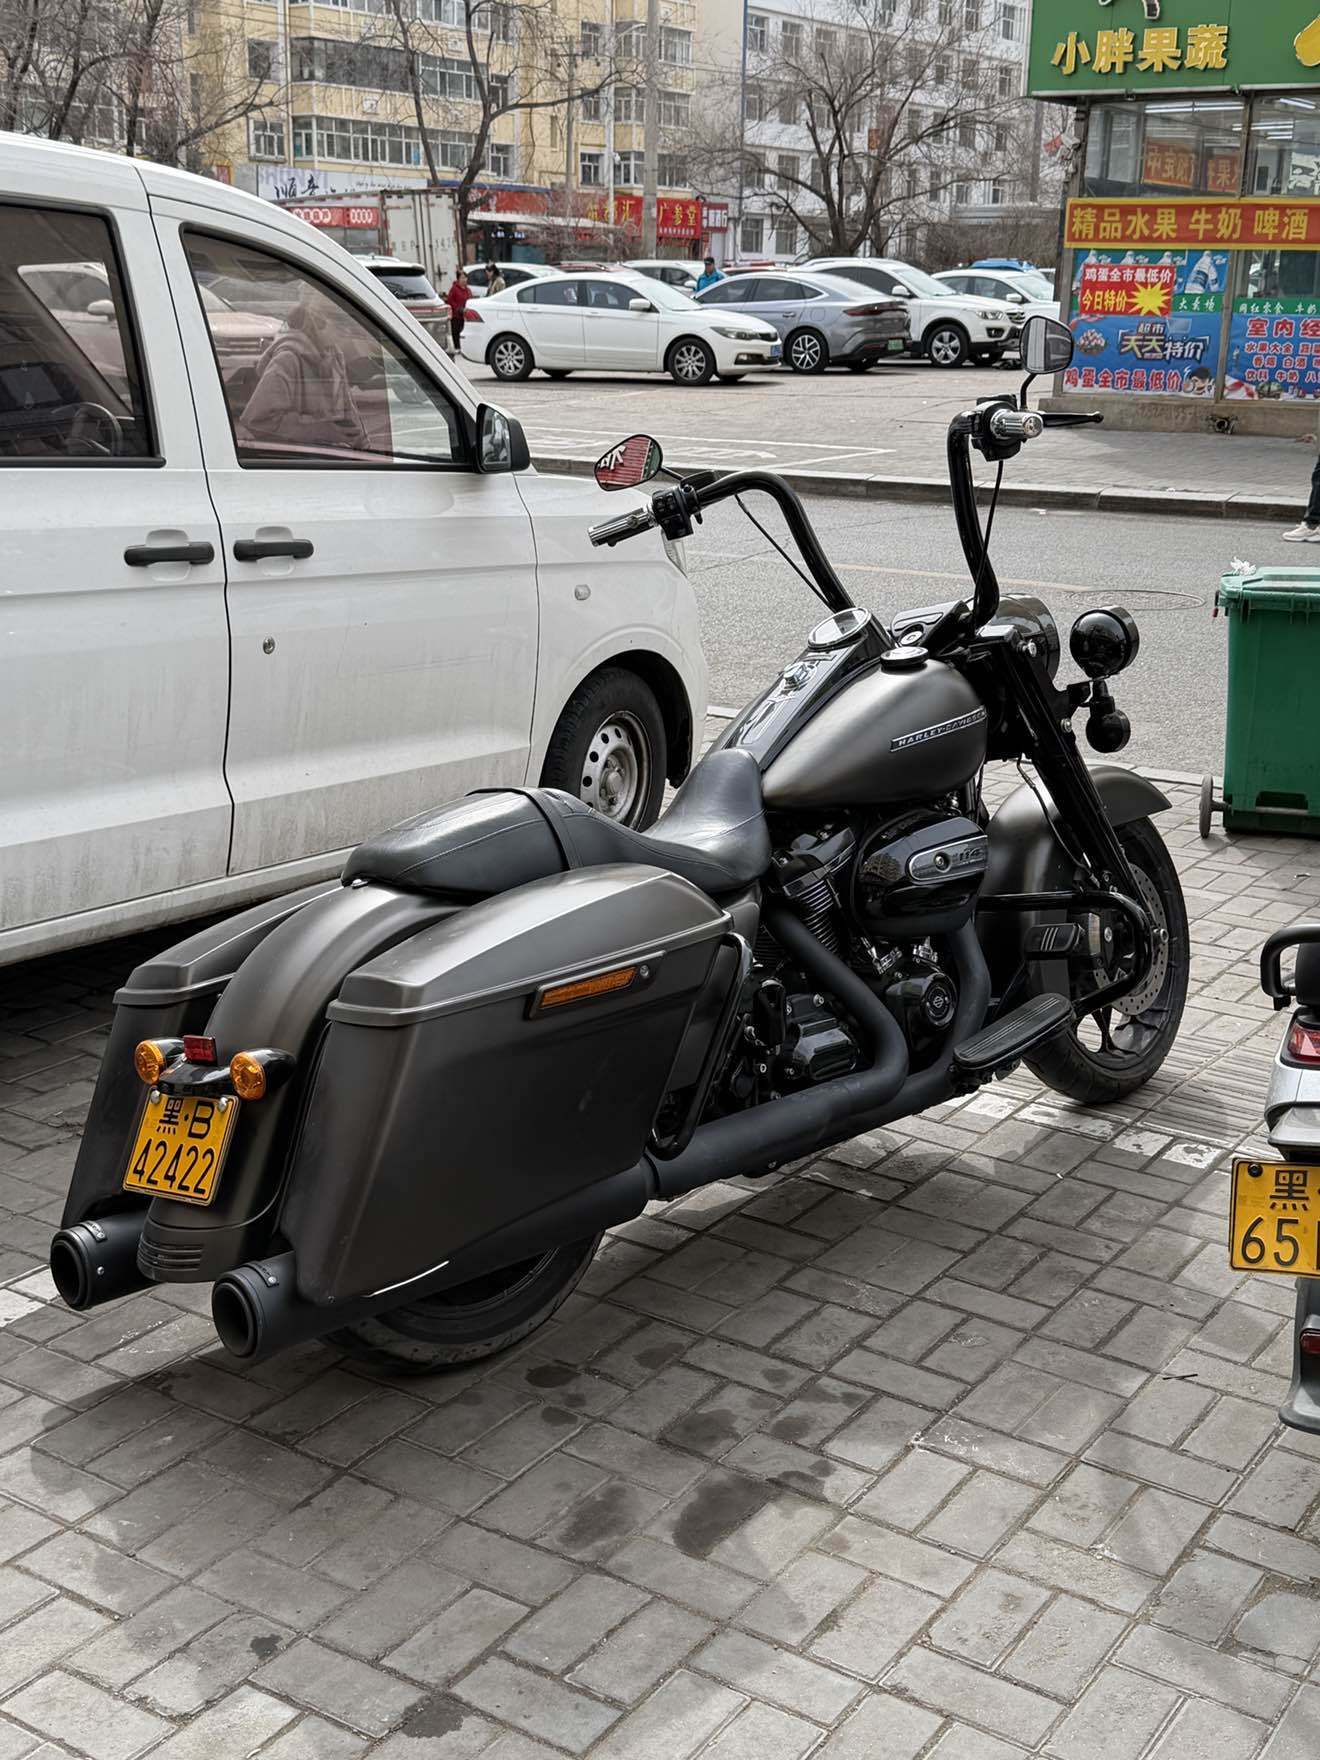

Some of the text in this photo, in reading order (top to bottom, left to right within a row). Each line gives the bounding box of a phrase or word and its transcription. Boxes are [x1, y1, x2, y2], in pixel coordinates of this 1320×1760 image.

[1051, 24, 1228, 75] 小胖果蔬
[1072, 207, 1309, 241] 精品水果 牛奶 啤酒
[1084, 267, 1172, 284] 鸡蛋全市最低价
[1082, 288, 1128, 312] 今日特价
[1138, 322, 1165, 335] 超市
[1121, 335, 1204, 361] 天天特价
[1065, 366, 1183, 393] 鸡蛋全市最低价
[897, 710, 987, 748] HARLEY-DAVIDSON
[132, 1138, 215, 1195] 42422
[1241, 1216, 1320, 1270] 65
